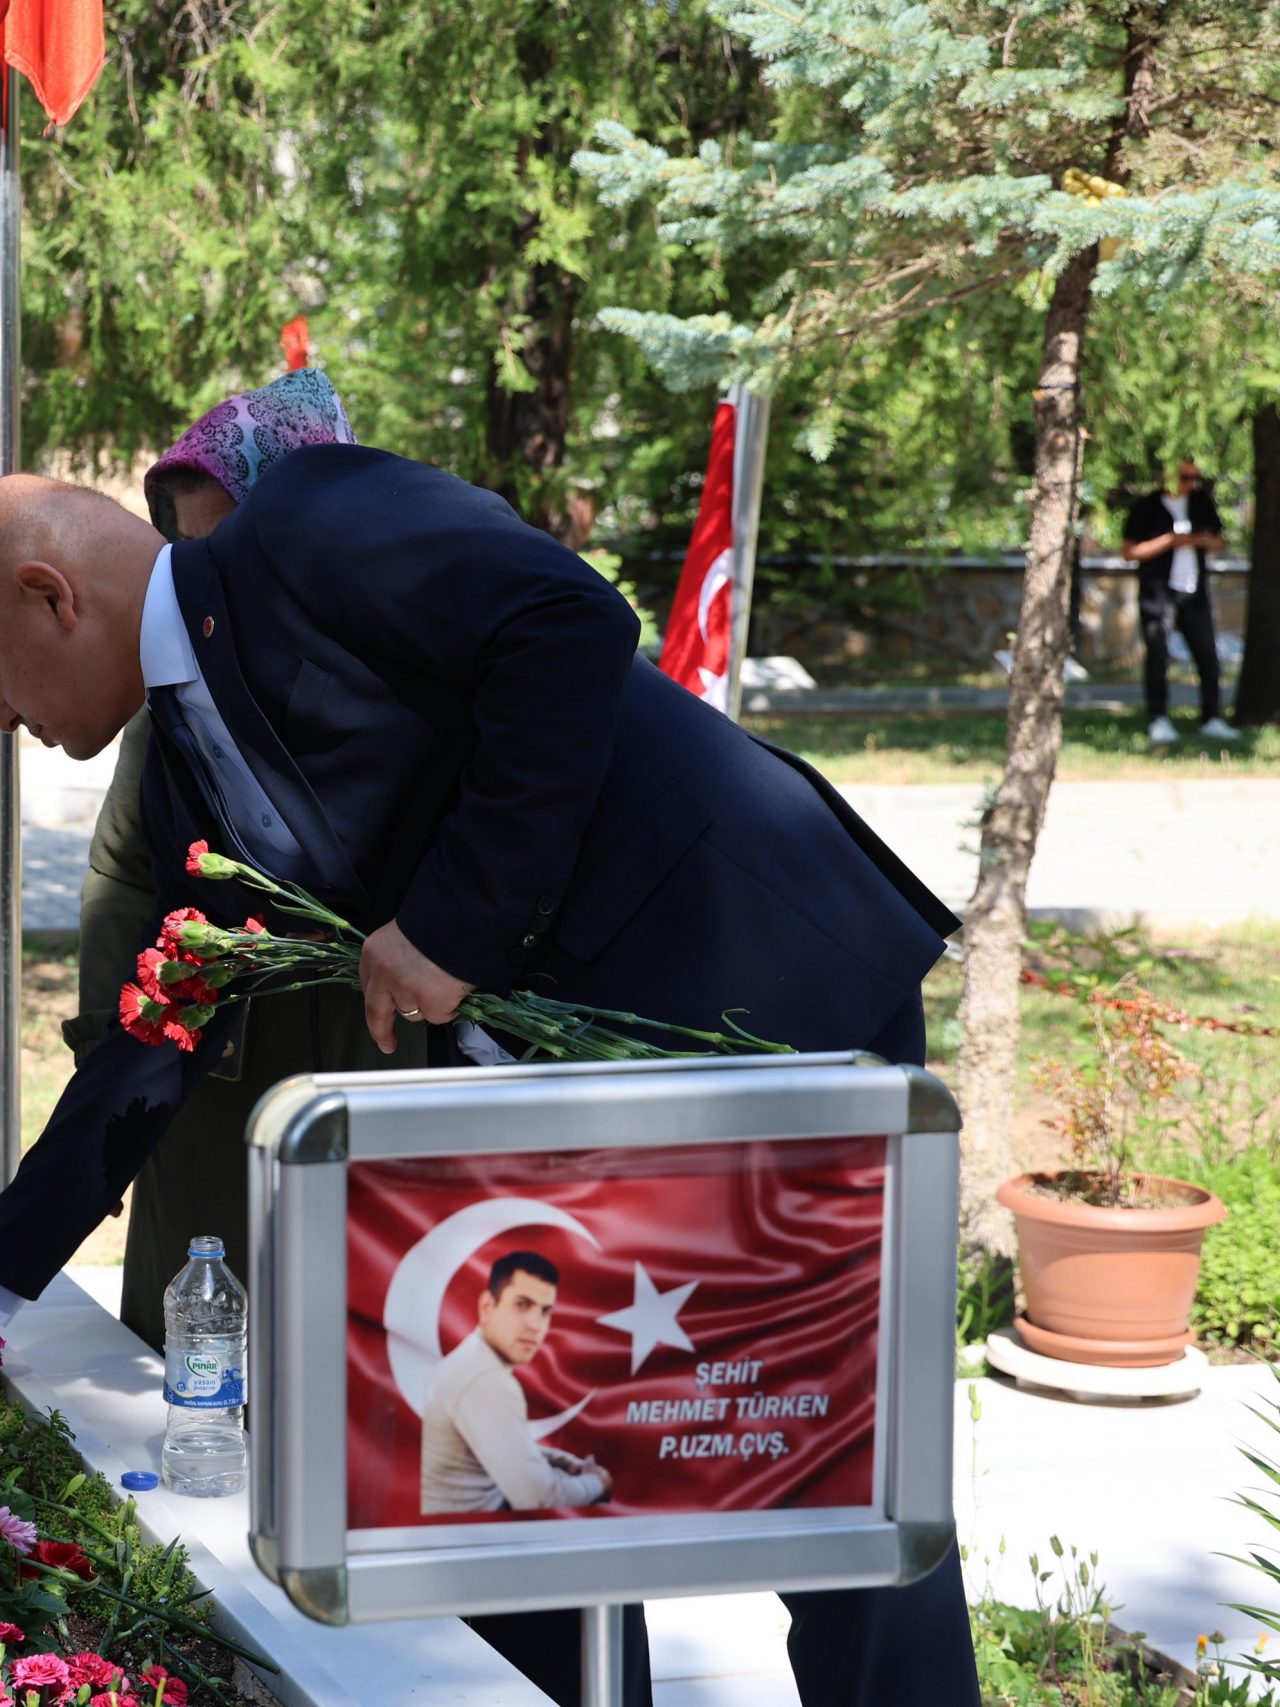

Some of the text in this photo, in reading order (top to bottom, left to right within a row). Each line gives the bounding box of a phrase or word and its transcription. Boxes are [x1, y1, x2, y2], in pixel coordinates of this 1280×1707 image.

[695, 1356, 763, 1391] ŞEHİT
[625, 1391, 830, 1425] MEHMET TÜRKEN
[658, 1430, 790, 1462] P.UZM.ÇVŞ.
